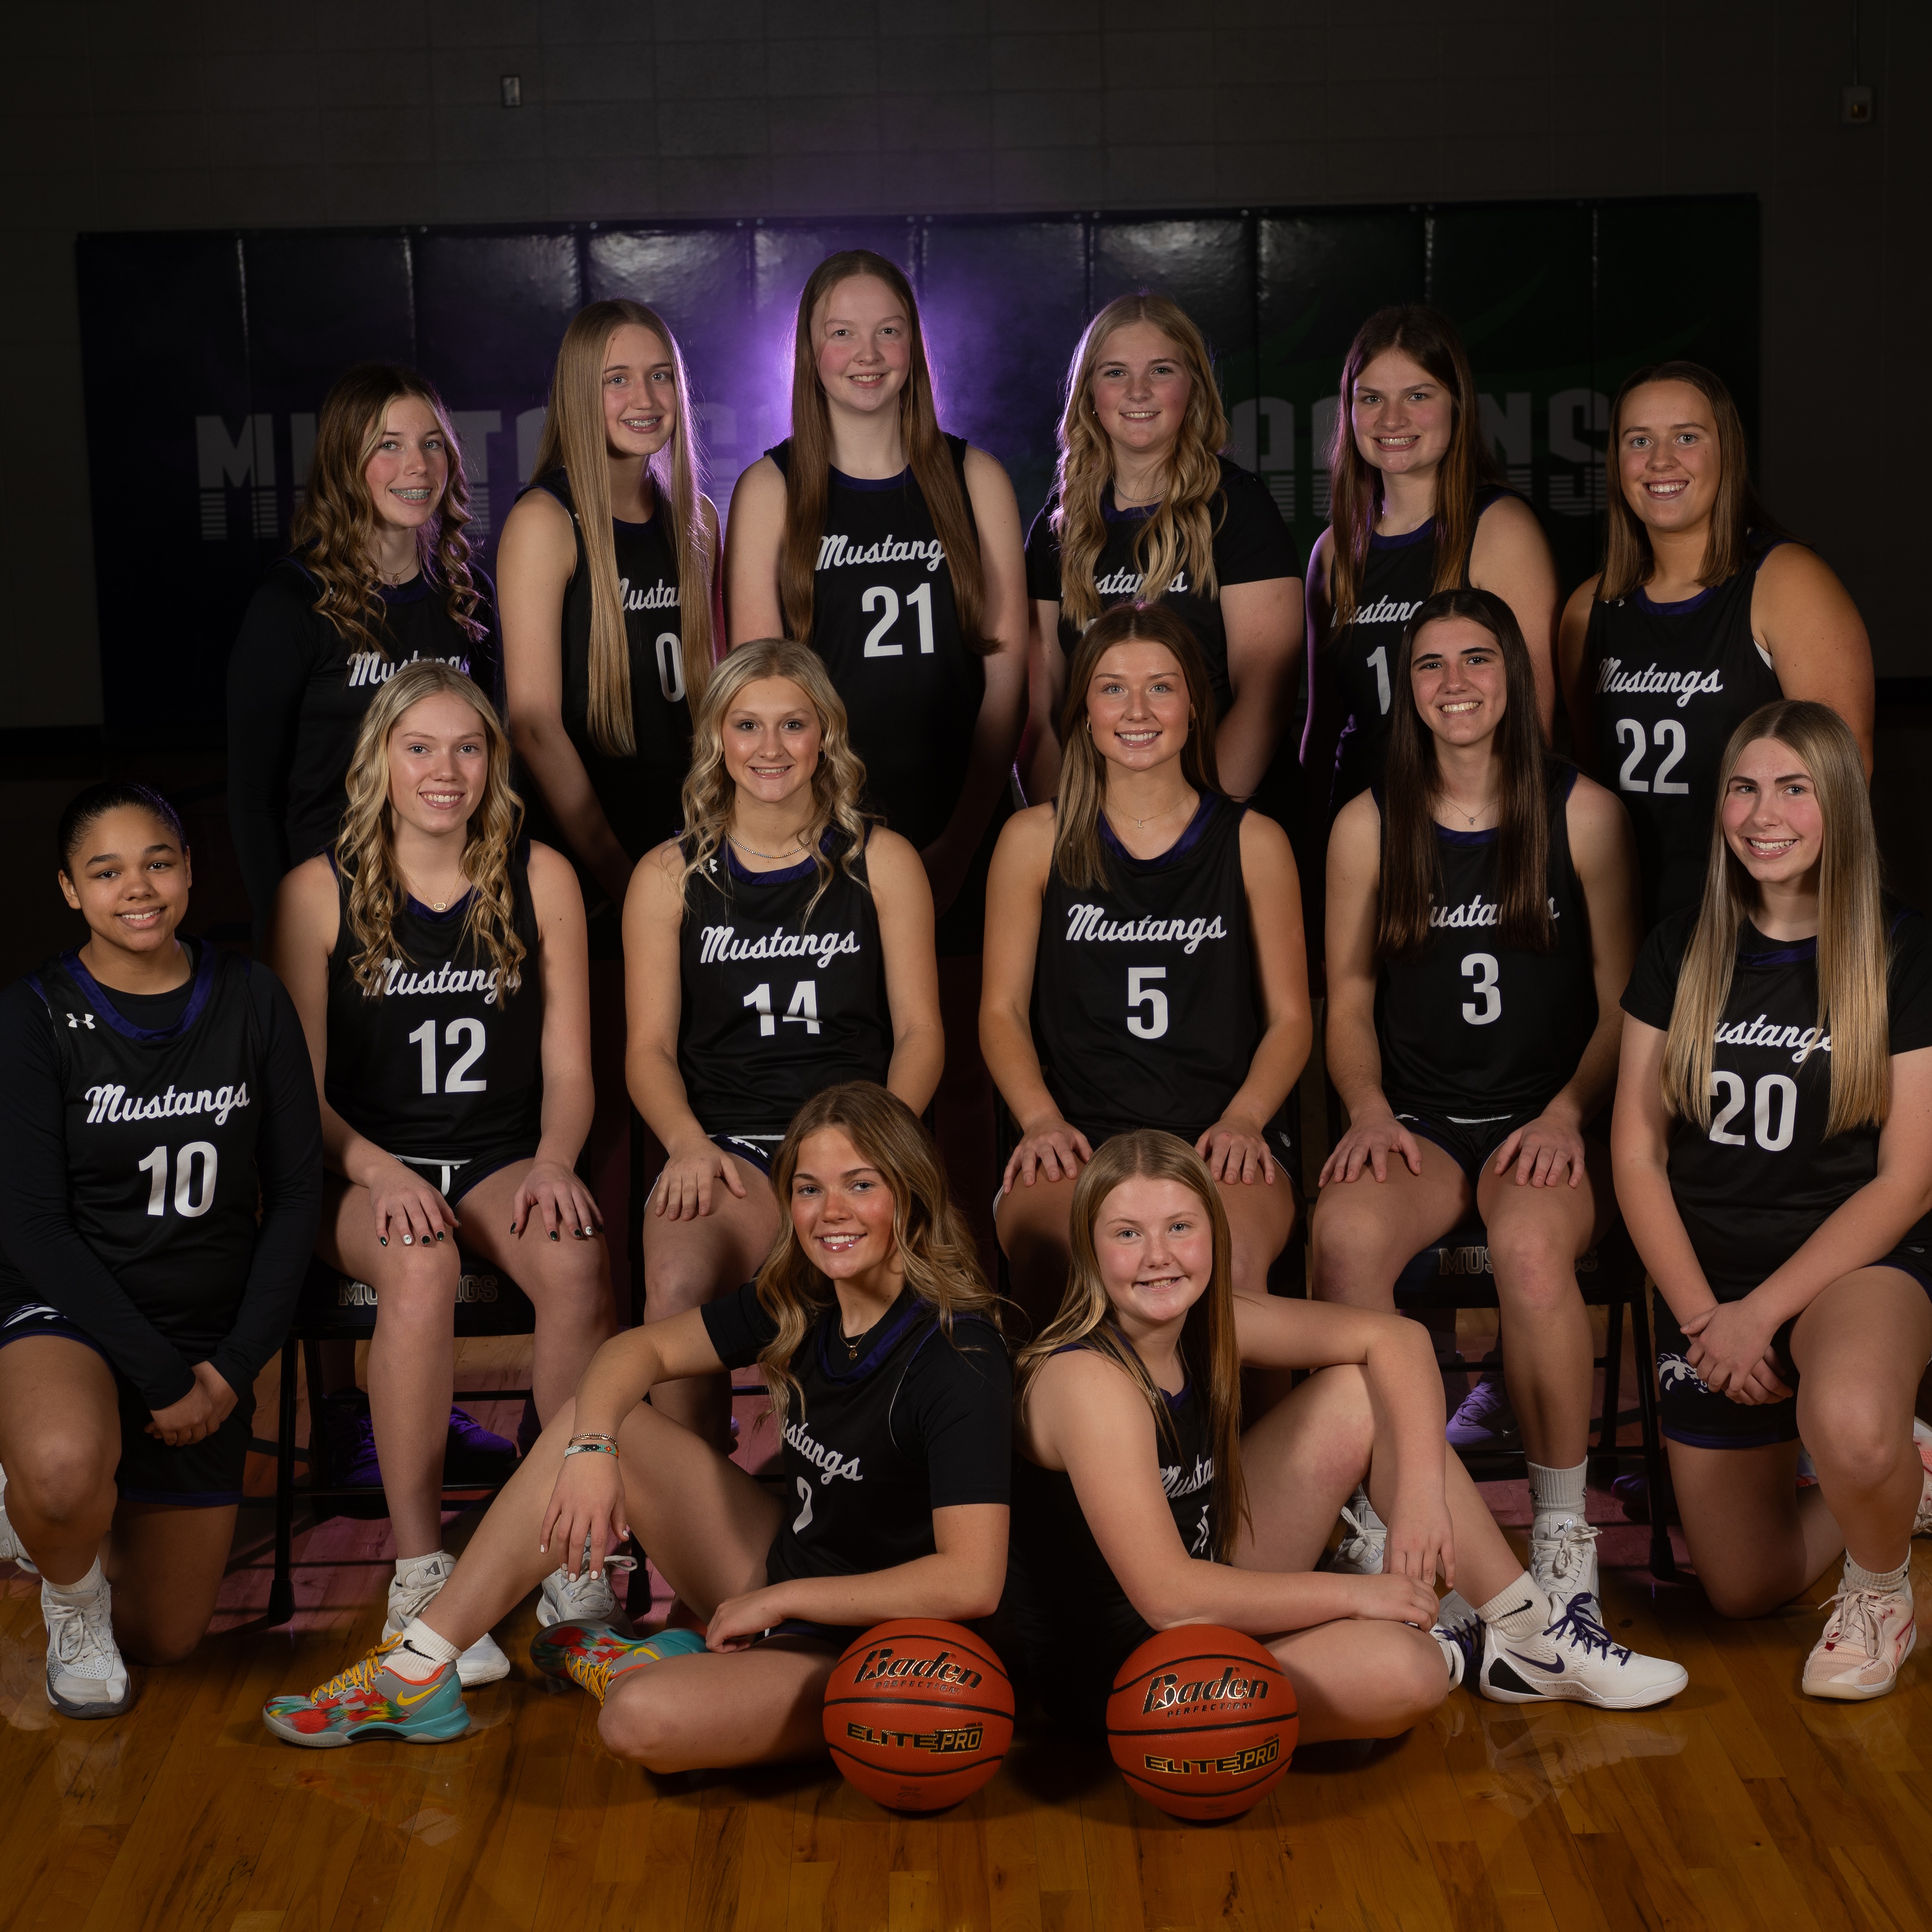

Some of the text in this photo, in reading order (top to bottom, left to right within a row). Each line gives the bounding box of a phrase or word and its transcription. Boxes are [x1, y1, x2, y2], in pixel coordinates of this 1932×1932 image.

[814, 534, 947, 572] Mustang
[862, 582, 934, 657] 21
[1595, 657, 1724, 707] Mustangs
[1616, 718, 1689, 794] 22
[700, 925, 860, 968] Mustangs
[1066, 904, 1227, 954] Mustangs
[743, 980, 823, 1037] 14
[1127, 966, 1169, 1039] 5
[1460, 953, 1502, 1025] 3
[409, 1017, 487, 1094] 12
[84, 1081, 250, 1126] Mustangs
[1709, 1070, 1797, 1152] 20
[138, 1141, 218, 1218] 10
[853, 1647, 983, 1690] Baden
[875, 1679, 958, 1693] PERFECTION
[1142, 1666, 1269, 1715] Baden
[1167, 1702, 1249, 1718] PERFECTION
